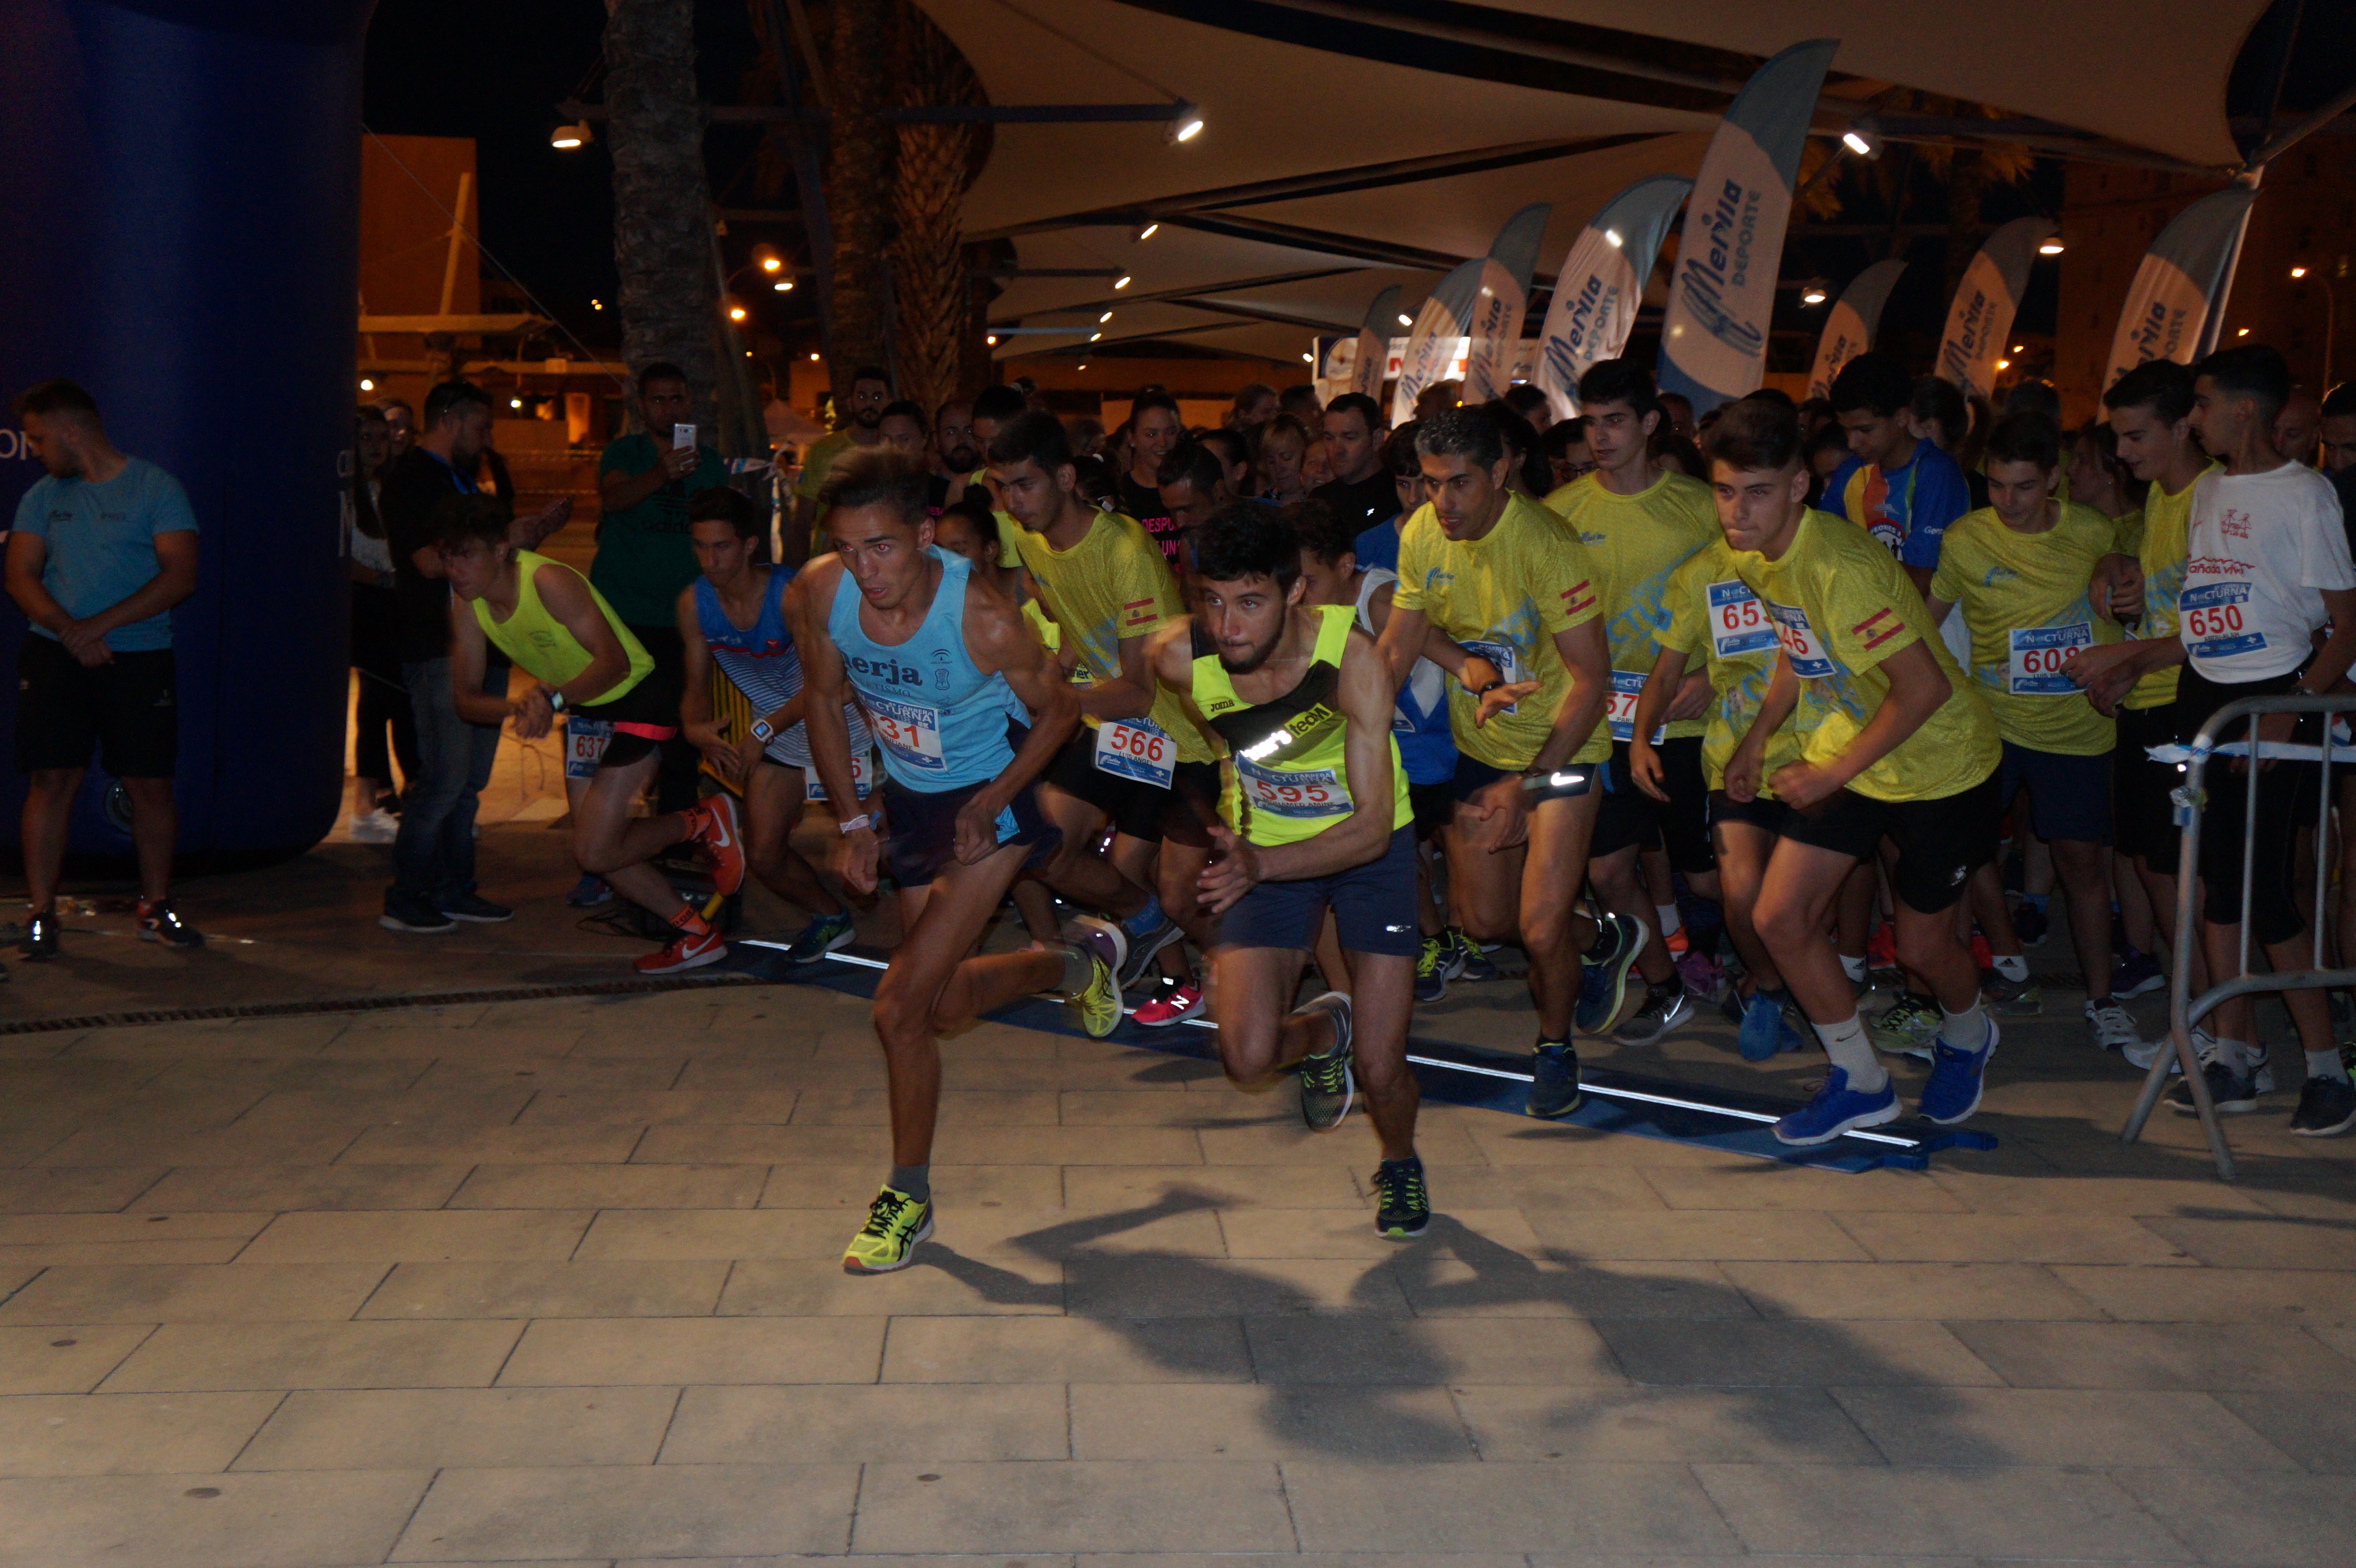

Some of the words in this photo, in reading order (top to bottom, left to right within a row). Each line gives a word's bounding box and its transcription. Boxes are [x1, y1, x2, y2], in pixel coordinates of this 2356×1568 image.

[1732, 190, 1761, 286] DEPORTE
[1583, 285, 1619, 361] DEPORTE
[2162, 309, 2187, 358] ORTE
[2189, 604, 2242, 636] 650
[897, 705, 934, 717] CARRERA
[576, 736, 605, 759] 637
[1111, 725, 1165, 762] 566
[1119, 751, 1132, 760] LUIS
[1134, 756, 1153, 767] ANGEL
[1257, 780, 1330, 802] 595
